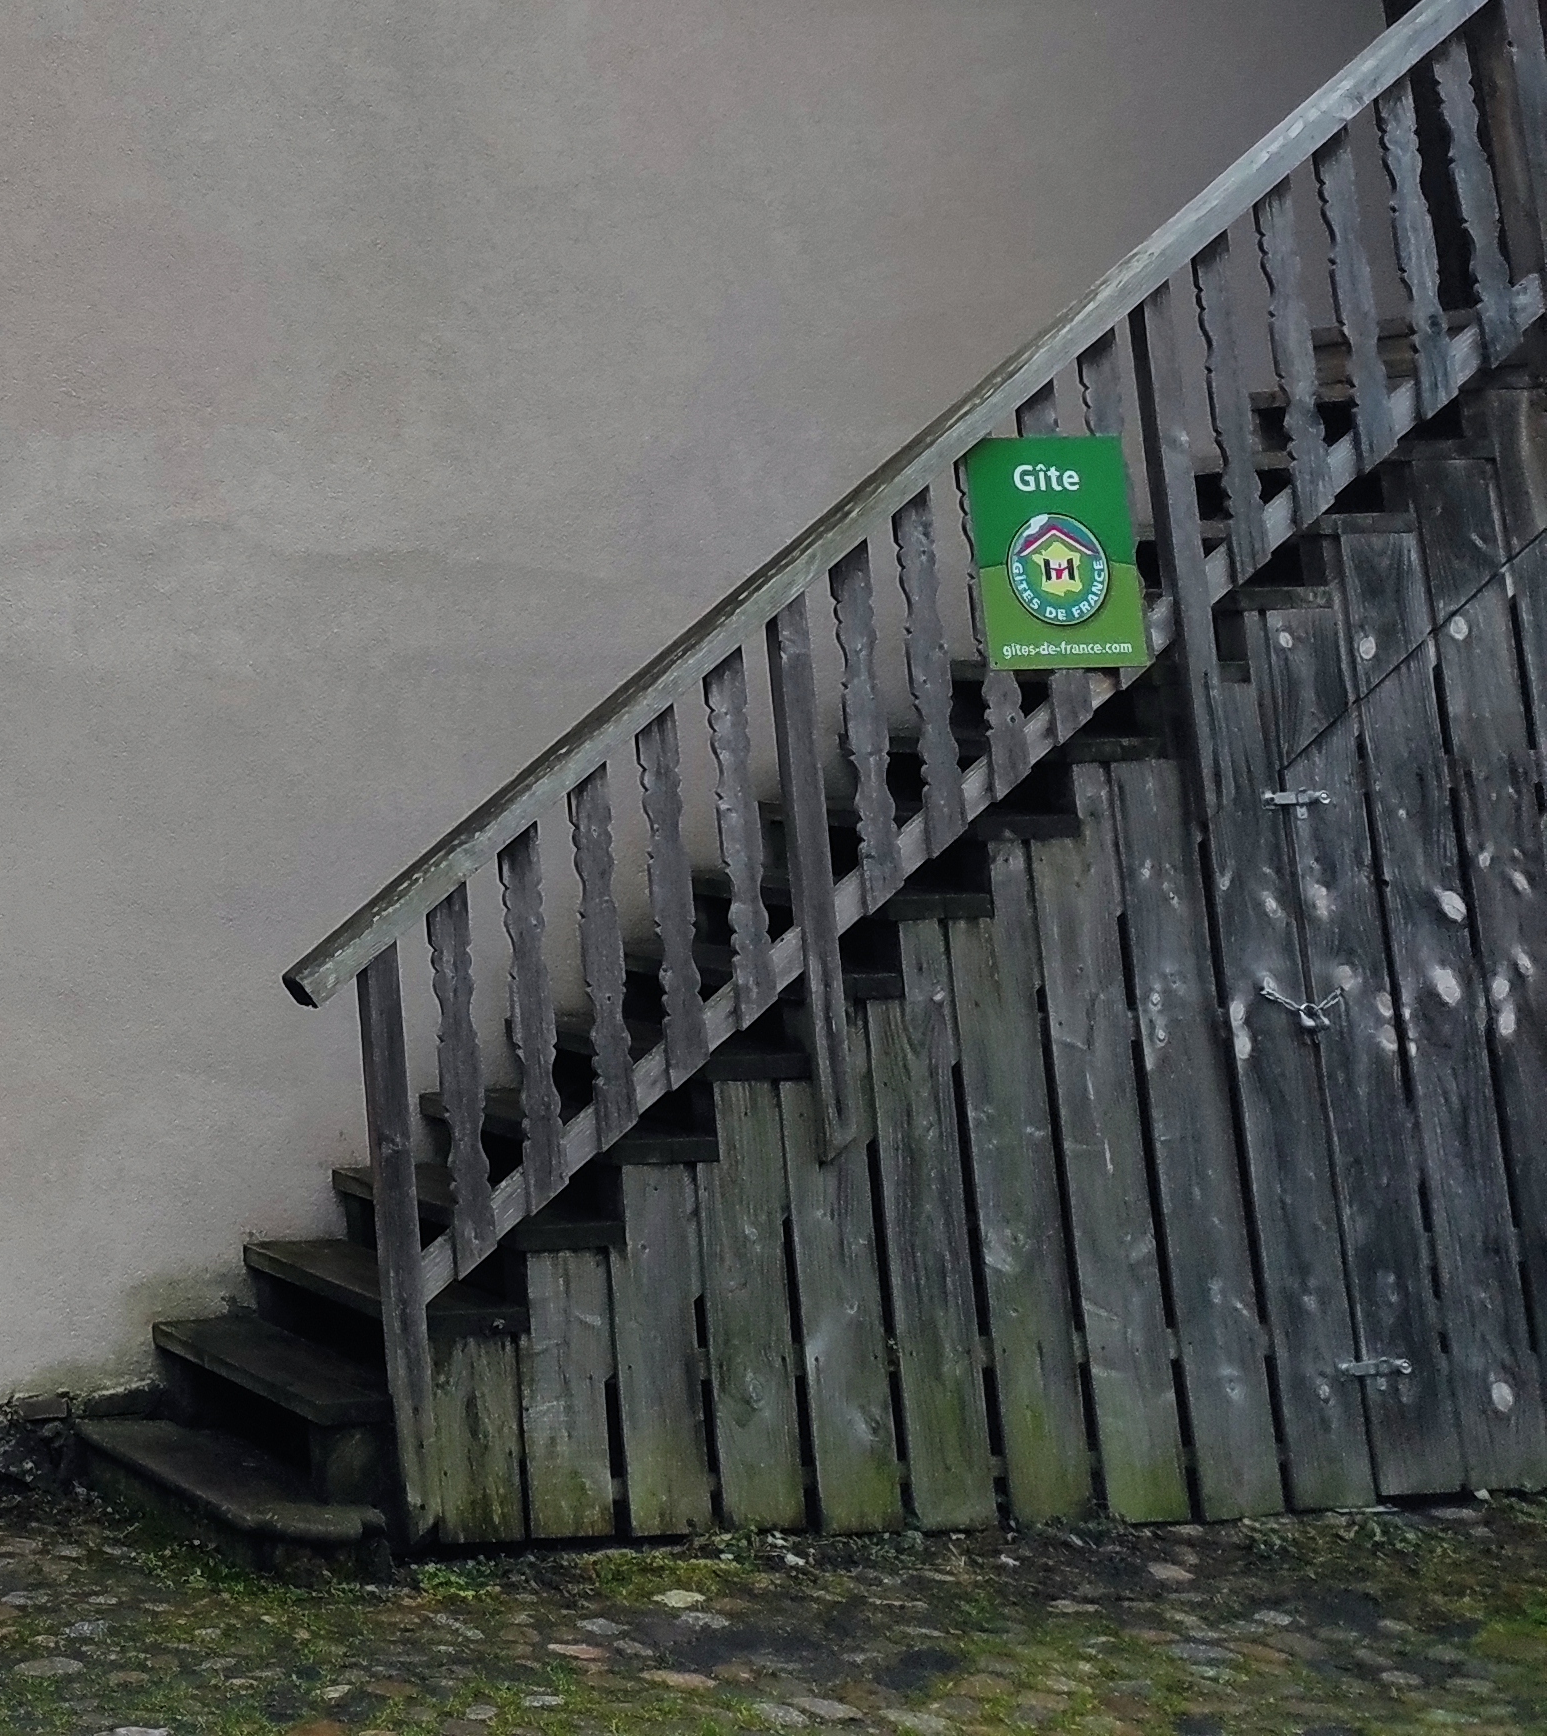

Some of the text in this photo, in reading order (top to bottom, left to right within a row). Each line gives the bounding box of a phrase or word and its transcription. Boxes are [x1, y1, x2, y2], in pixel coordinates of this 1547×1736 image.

[1013, 463, 1081, 492] Gîte
[1045, 606, 1067, 621] DE
[1071, 559, 1105, 618] FRANCE
